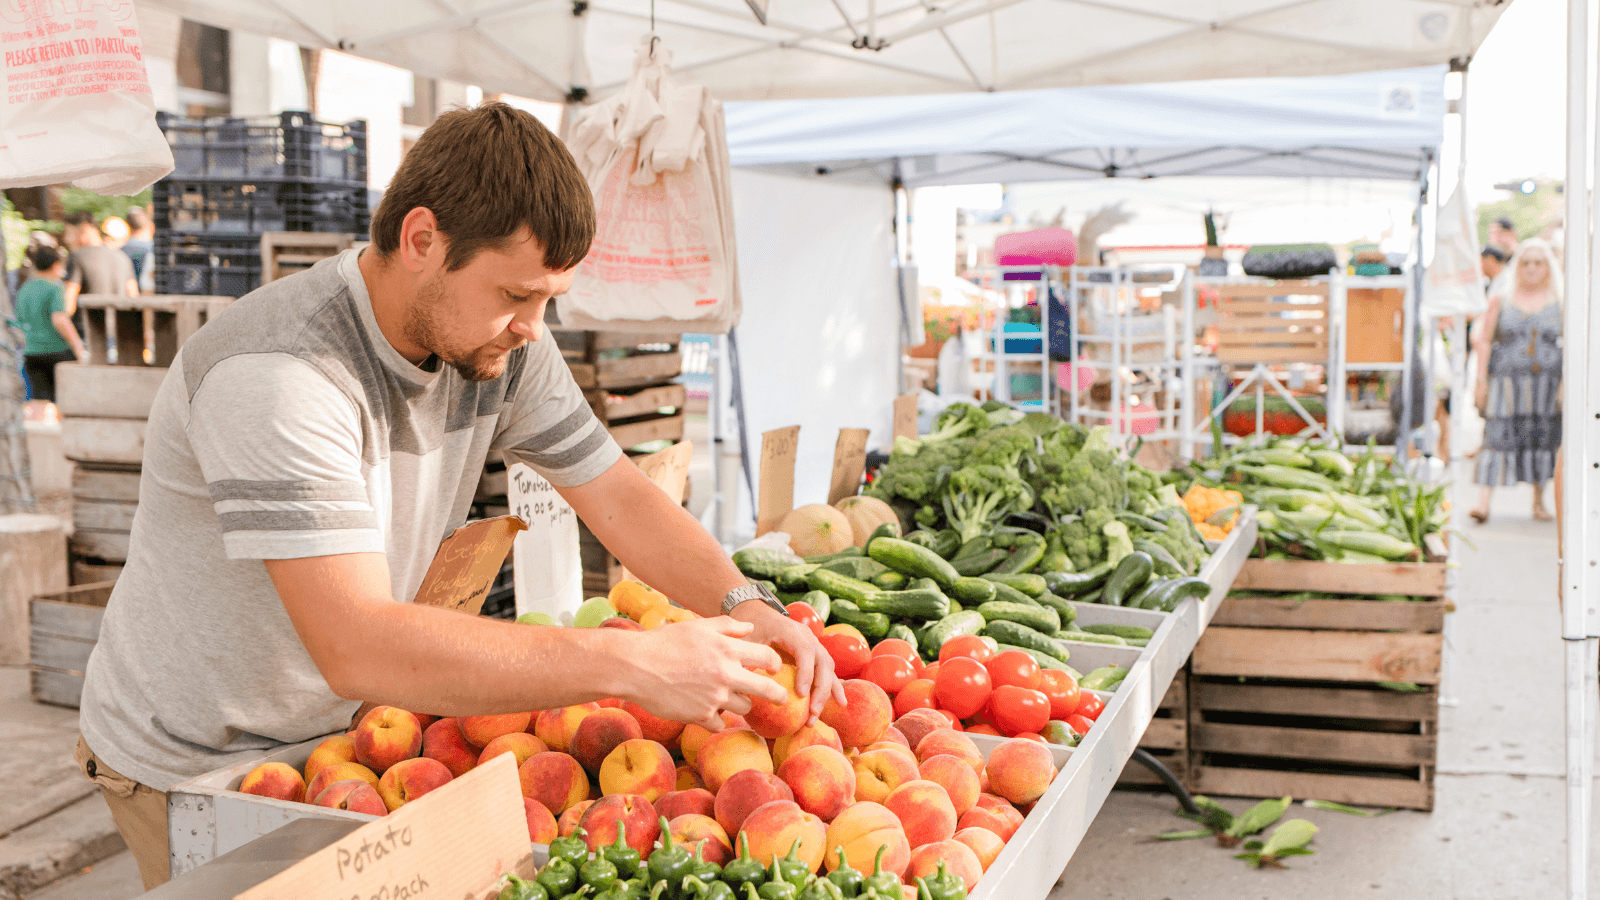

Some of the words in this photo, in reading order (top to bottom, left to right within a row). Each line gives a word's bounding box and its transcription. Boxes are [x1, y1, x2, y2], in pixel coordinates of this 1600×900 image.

[74, 18, 98, 31] Day
[5, 47, 38, 67] PLEASE
[39, 41, 75, 61] RETURN
[74, 38, 89, 55] TO
[337, 825, 412, 880] Potato
